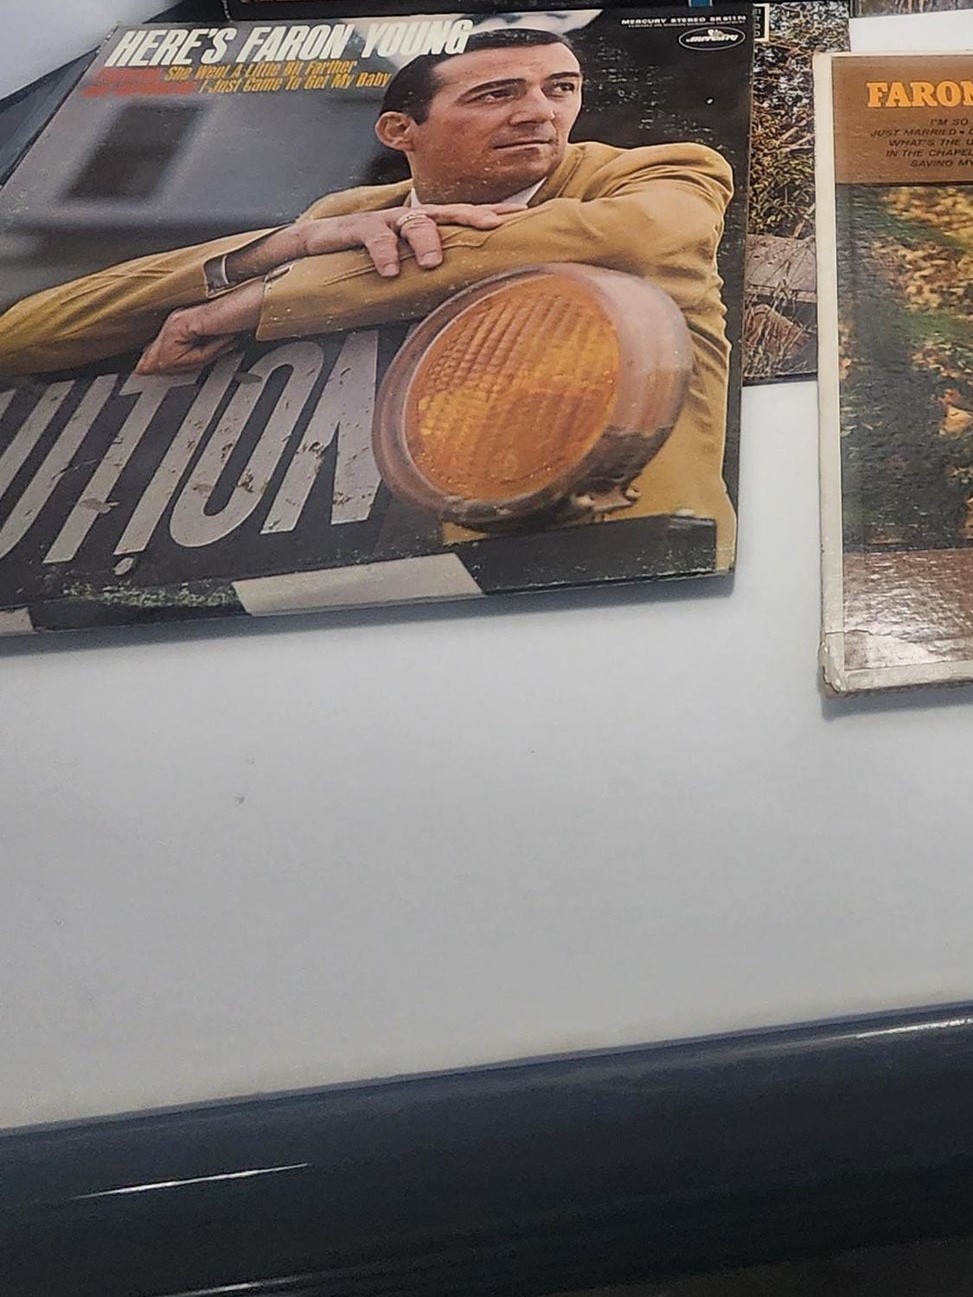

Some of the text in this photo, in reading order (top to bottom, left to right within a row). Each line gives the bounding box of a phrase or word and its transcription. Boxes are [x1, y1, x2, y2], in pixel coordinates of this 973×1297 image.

[103, 18, 474, 68] HERE'S FARON YOUNG
[231, 63, 244, 77] A
[331, 72, 356, 89] My
[356, 71, 392, 88] Baby
